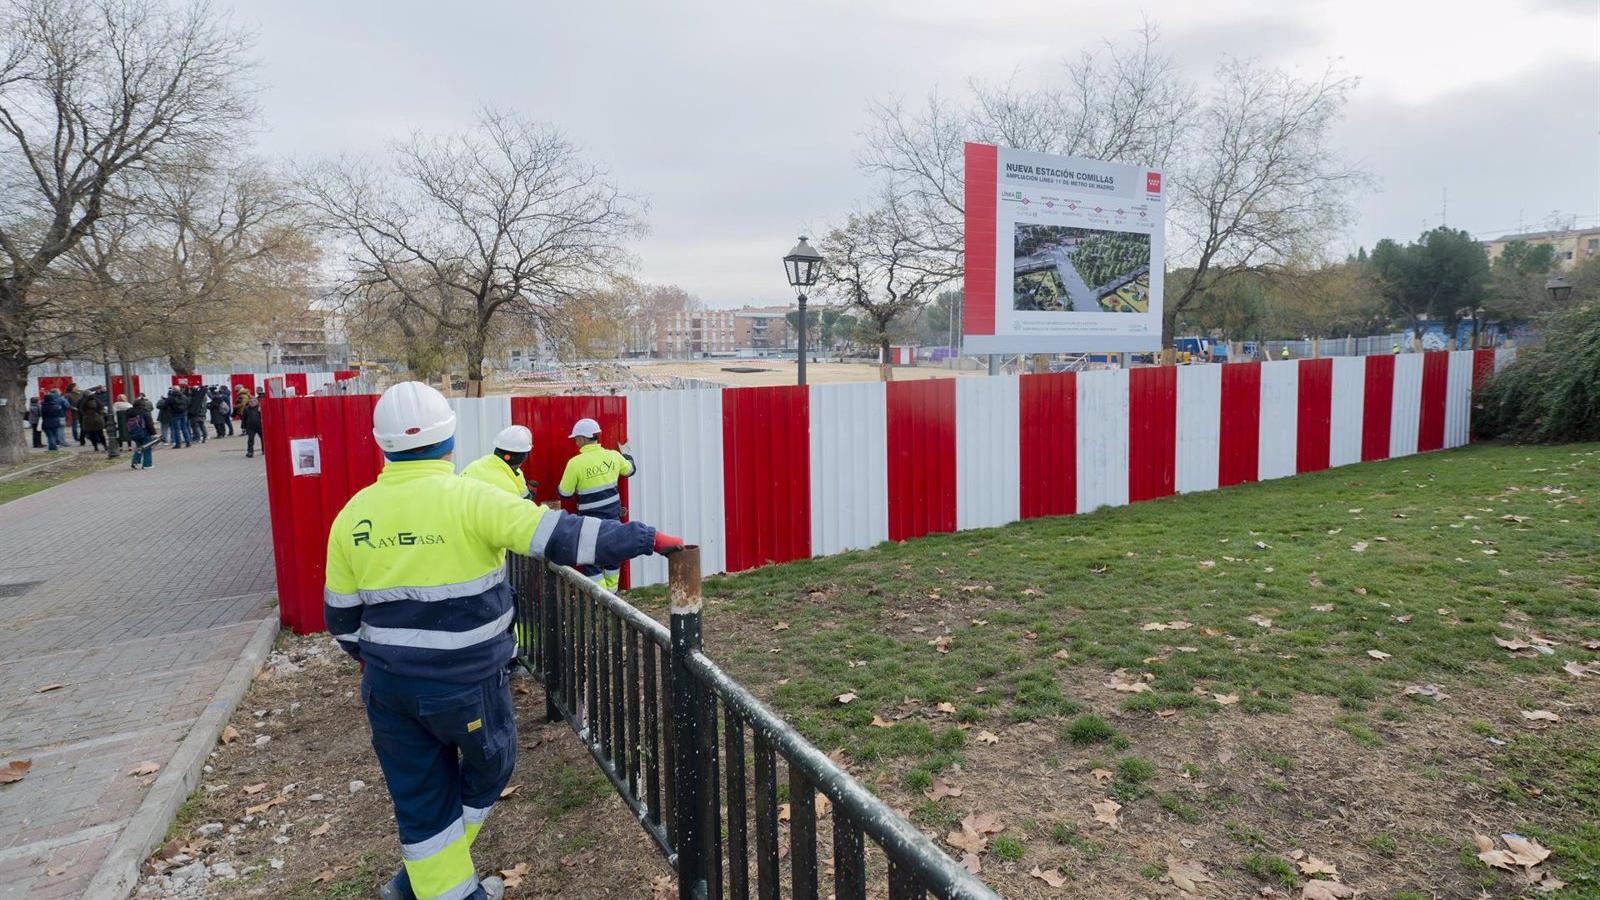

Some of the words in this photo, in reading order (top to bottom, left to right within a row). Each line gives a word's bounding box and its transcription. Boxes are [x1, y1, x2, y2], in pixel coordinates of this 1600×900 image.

[1006, 162, 1033, 174] NUEVA
[1036, 166, 1074, 179] ESTACIÓN
[1076, 172, 1114, 184] COMILLAS
[1096, 183, 1115, 191] MADRID
